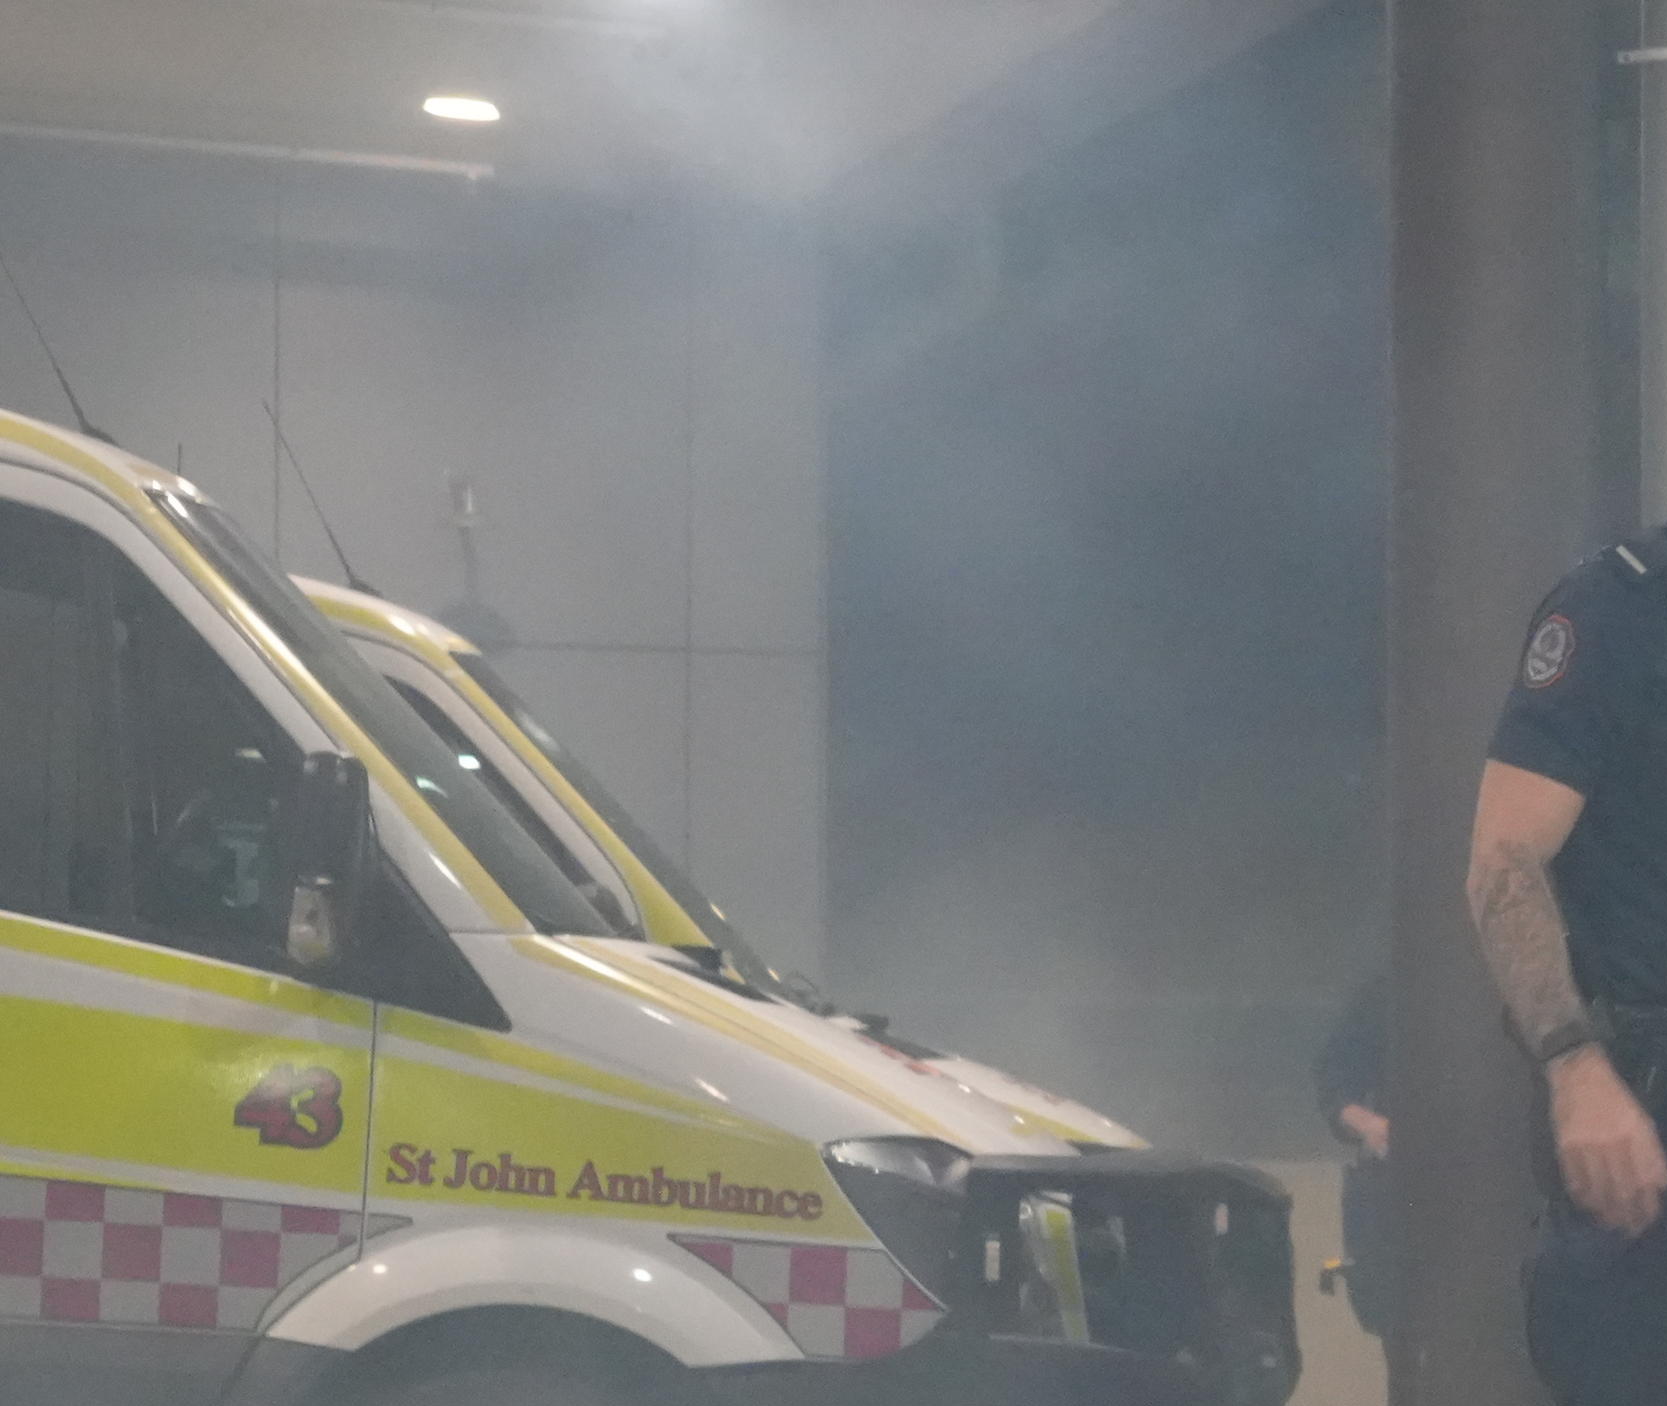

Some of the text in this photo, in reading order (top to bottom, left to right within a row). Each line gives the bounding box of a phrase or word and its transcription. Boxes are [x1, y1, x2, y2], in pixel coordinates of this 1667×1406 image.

[233, 1062, 344, 1150] 43
[385, 1142, 824, 1221] St John Ambulance
